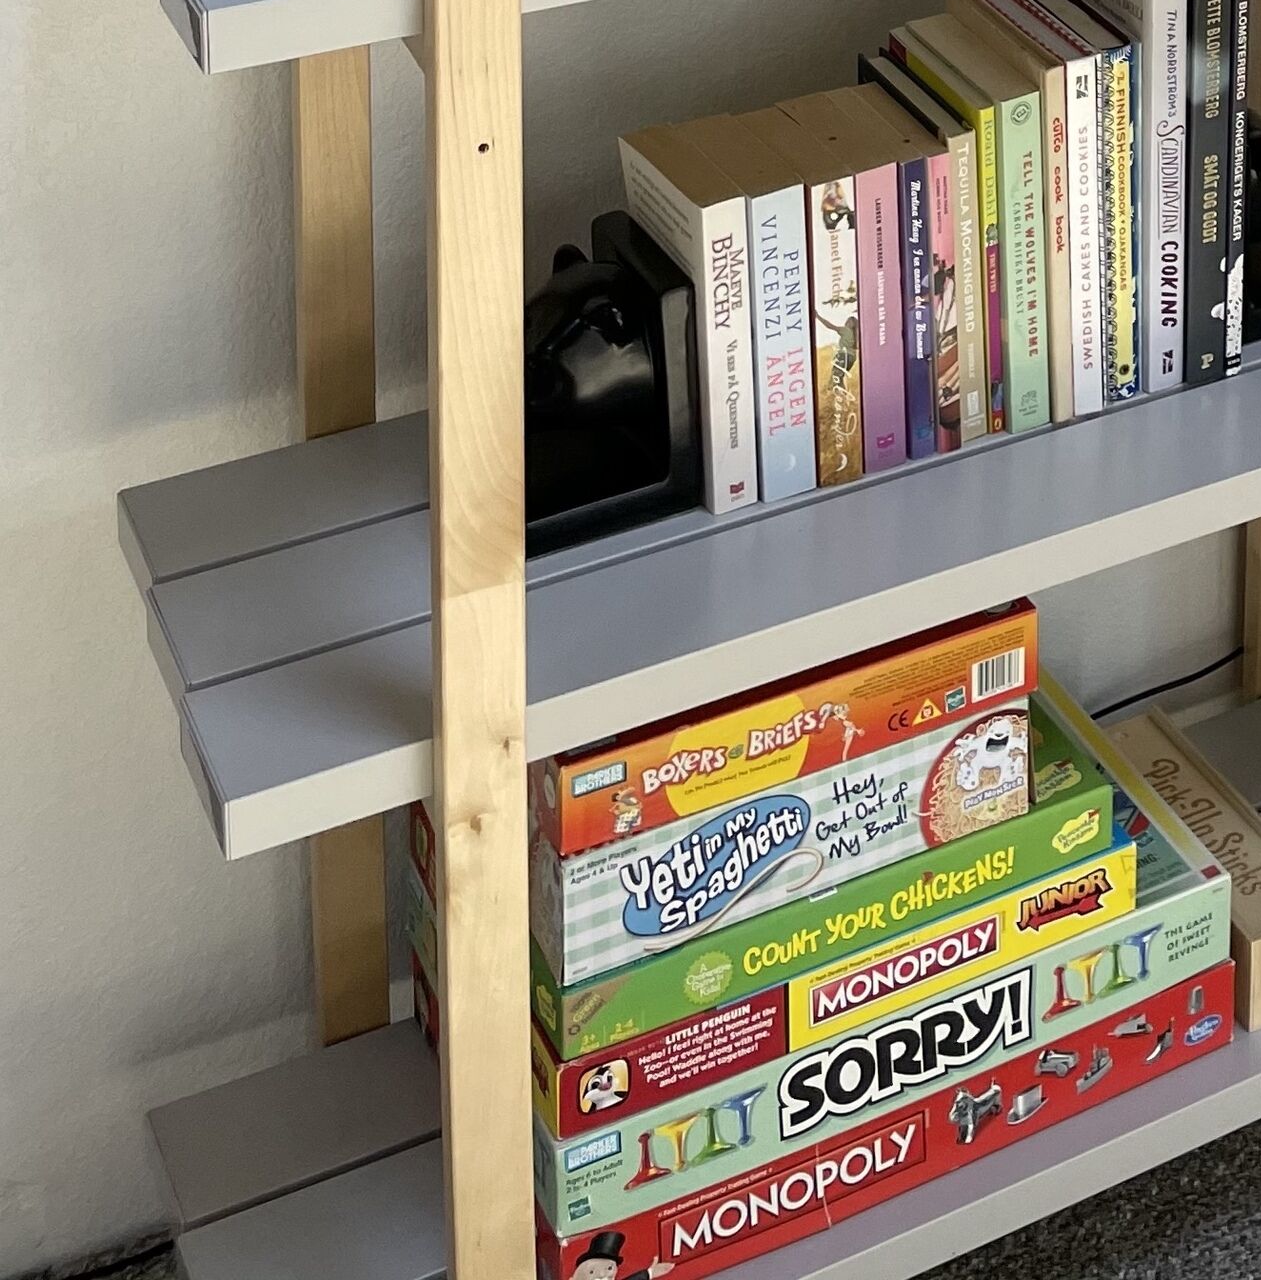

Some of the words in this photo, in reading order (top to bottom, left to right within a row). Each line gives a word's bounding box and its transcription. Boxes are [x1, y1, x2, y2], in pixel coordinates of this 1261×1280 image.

[1166, 9, 1178, 41] TINA
[1236, 0, 1248, 102] BLOMSTERBERG
[1204, 27, 1221, 119] BLOMSTERBERG
[983, 120, 995, 168] Roald
[1117, 88, 1126, 155] FINNISH
[957, 142, 969, 220] TEQUILA
[1023, 150, 1033, 187] TELL
[1078, 126, 1089, 196] COOKIES
[1233, 111, 1245, 197] KONGERIGETS
[986, 175, 998, 220] Dahl
[1024, 193, 1034, 220] THE
[1118, 156, 1127, 217] COOKBOOK
[1203, 191, 1217, 209] OG
[1080, 203, 1090, 235] AND
[1232, 199, 1243, 242] KAGER
[711, 233, 733, 331] BINCHY
[729, 246, 745, 311] MAEVE
[761, 214, 782, 341] VINCENZI
[960, 222, 976, 333] MOCKINGBIRD
[1026, 226, 1036, 286] WOLVES
[1081, 242, 1091, 291] CAKES
[1118, 226, 1127, 292] OJAKANGAS
[1160, 240, 1179, 328] COOKING
[783, 248, 804, 333] PENNY
[1029, 320, 1039, 358] HOME
[1082, 299, 1093, 371] SWEDISH
[767, 355, 787, 436] ÄNGEL
[787, 347, 807, 428] INGEN
[815, 816, 852, 842] Get
[855, 797, 888, 819] Out
[892, 781, 908, 804] of
[832, 773, 885, 805] Hey,
[620, 833, 706, 909] Yeti
[705, 835, 723, 860] in
[726, 807, 758, 839] My
[829, 834, 862, 859] My
[866, 805, 908, 842] Bowl!
[659, 807, 804, 933] Spaghetti
[1017, 867, 1114, 930] JUNIOR
[743, 929, 821, 977] COUNT
[825, 900, 887, 946] YOUR
[889, 845, 1017, 922] CHICKENS!
[1163, 925, 1185, 940] THE
[1185, 911, 1214, 932] GAME
[1166, 938, 1179, 951] OF
[1182, 924, 1212, 946] SWEET
[816, 923, 995, 1019] MONOPOLY
[1167, 937, 1210, 963] REVENGE
[638, 1048, 667, 1066] Hello!
[725, 1017, 750, 1032] home
[762, 1006, 777, 1017] the
[665, 1024, 700, 1045] LITTLE
[702, 1003, 751, 1031] PENGUIN
[713, 1035, 728, 1047] the
[781, 967, 1030, 1137] SORRY!
[659, 1074, 678, 1088] and
[672, 1123, 916, 1257] MONOPOLY
